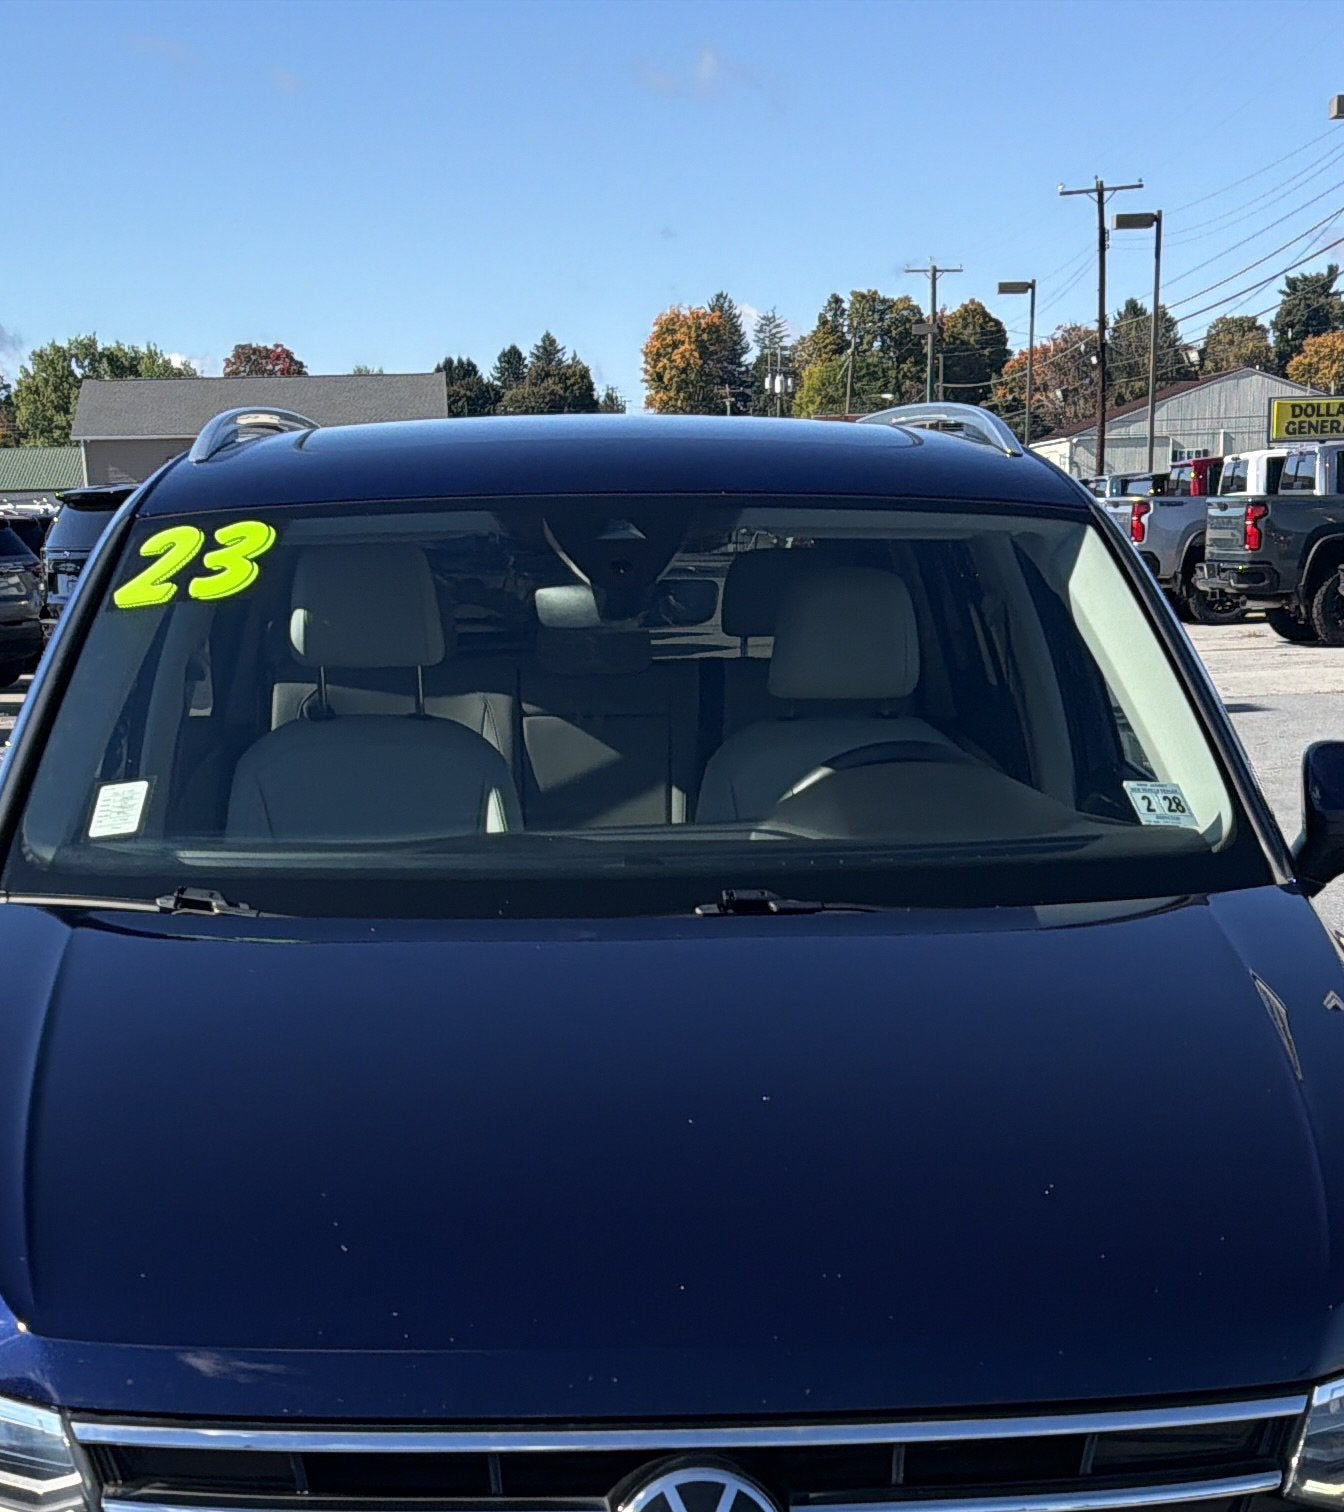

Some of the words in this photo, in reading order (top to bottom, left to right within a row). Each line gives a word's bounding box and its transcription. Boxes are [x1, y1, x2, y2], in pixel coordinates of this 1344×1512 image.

[114, 521, 277, 608] 23
[1141, 795, 1156, 812] 2
[1162, 795, 1186, 813] 28
